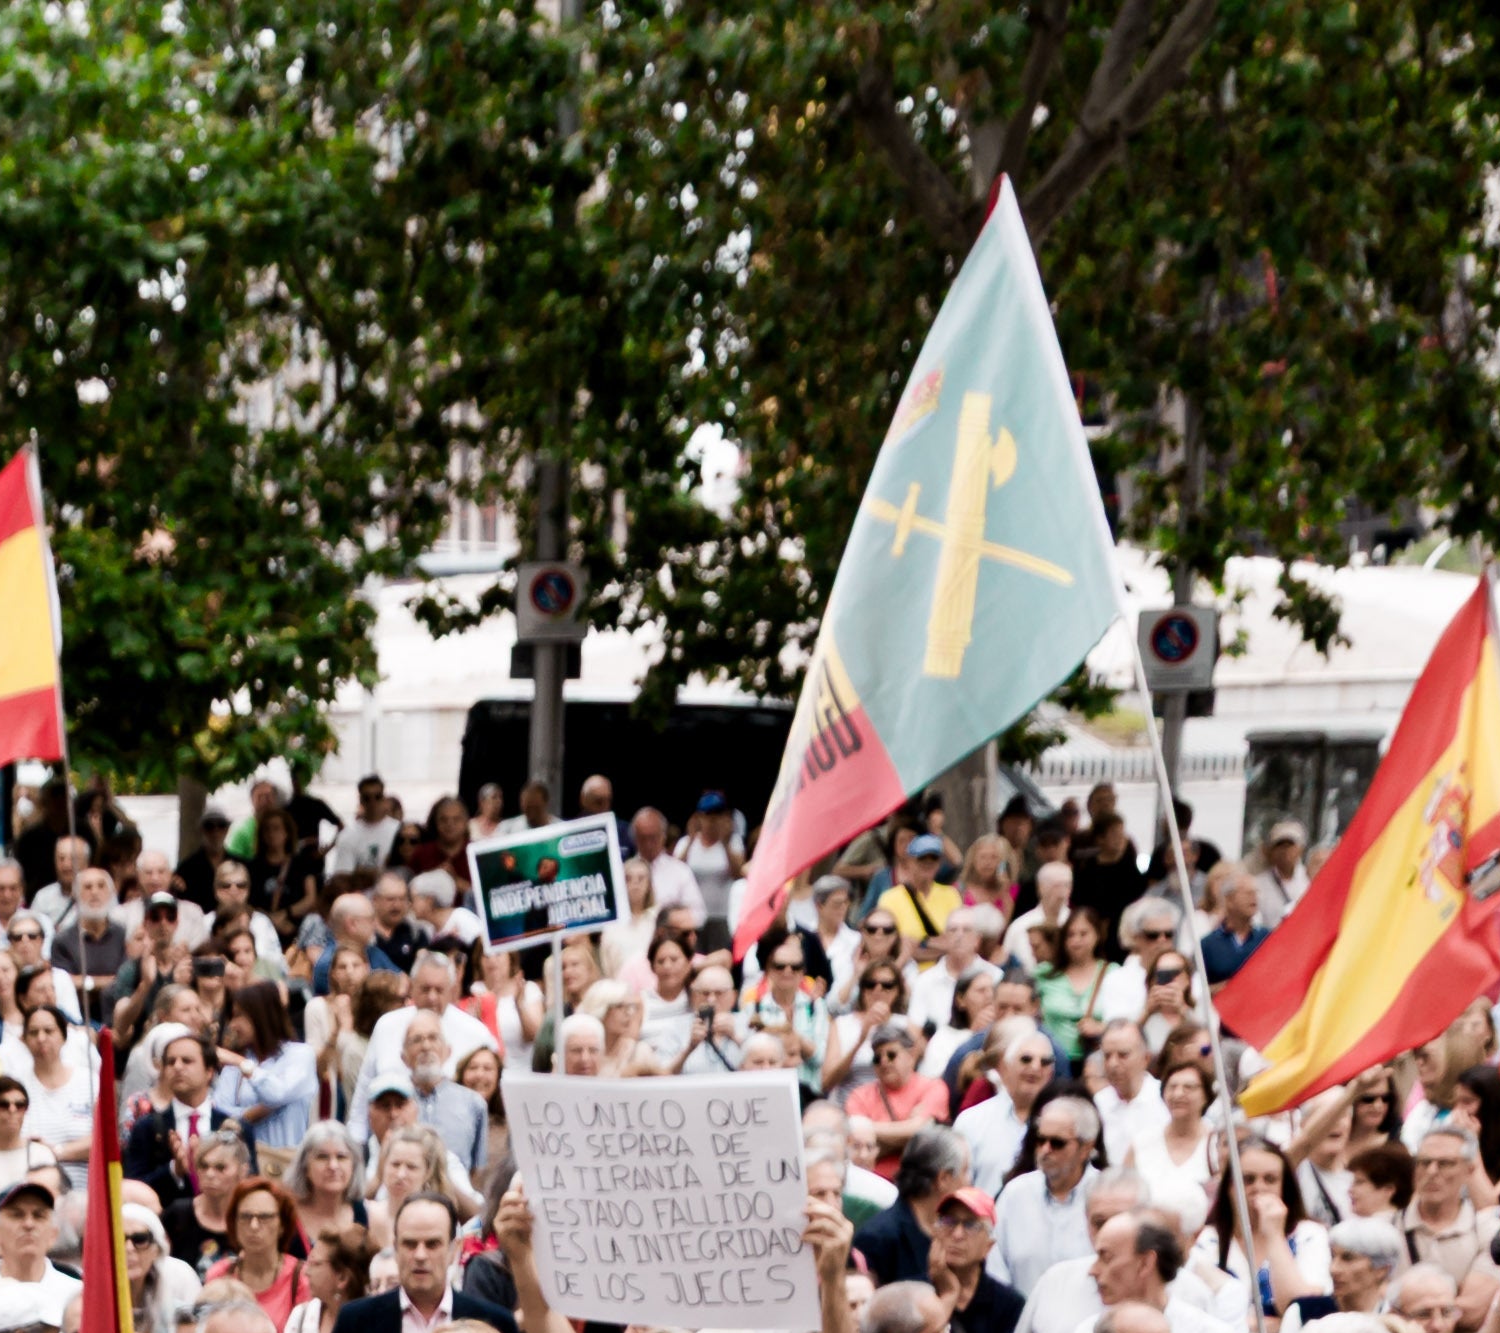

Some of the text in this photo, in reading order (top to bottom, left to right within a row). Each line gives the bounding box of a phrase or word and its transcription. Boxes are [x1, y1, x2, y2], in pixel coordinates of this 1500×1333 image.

[490, 873, 606, 919] INDEPENDENCIA
[548, 894, 610, 925] JUDICIAL
[522, 1101, 565, 1130] LO
[706, 1098, 769, 1128] QUE
[528, 1131, 751, 1159] NOS SEPARA DE
[535, 1163, 566, 1191] LA
[718, 1160, 755, 1187] DE
[766, 1156, 802, 1183] UN
[541, 1191, 775, 1229] ESTADO FALLIDO
[550, 1227, 805, 1264] ES LA INTEGRIDAD
[553, 1265, 797, 1306] DE LOS JUECES
